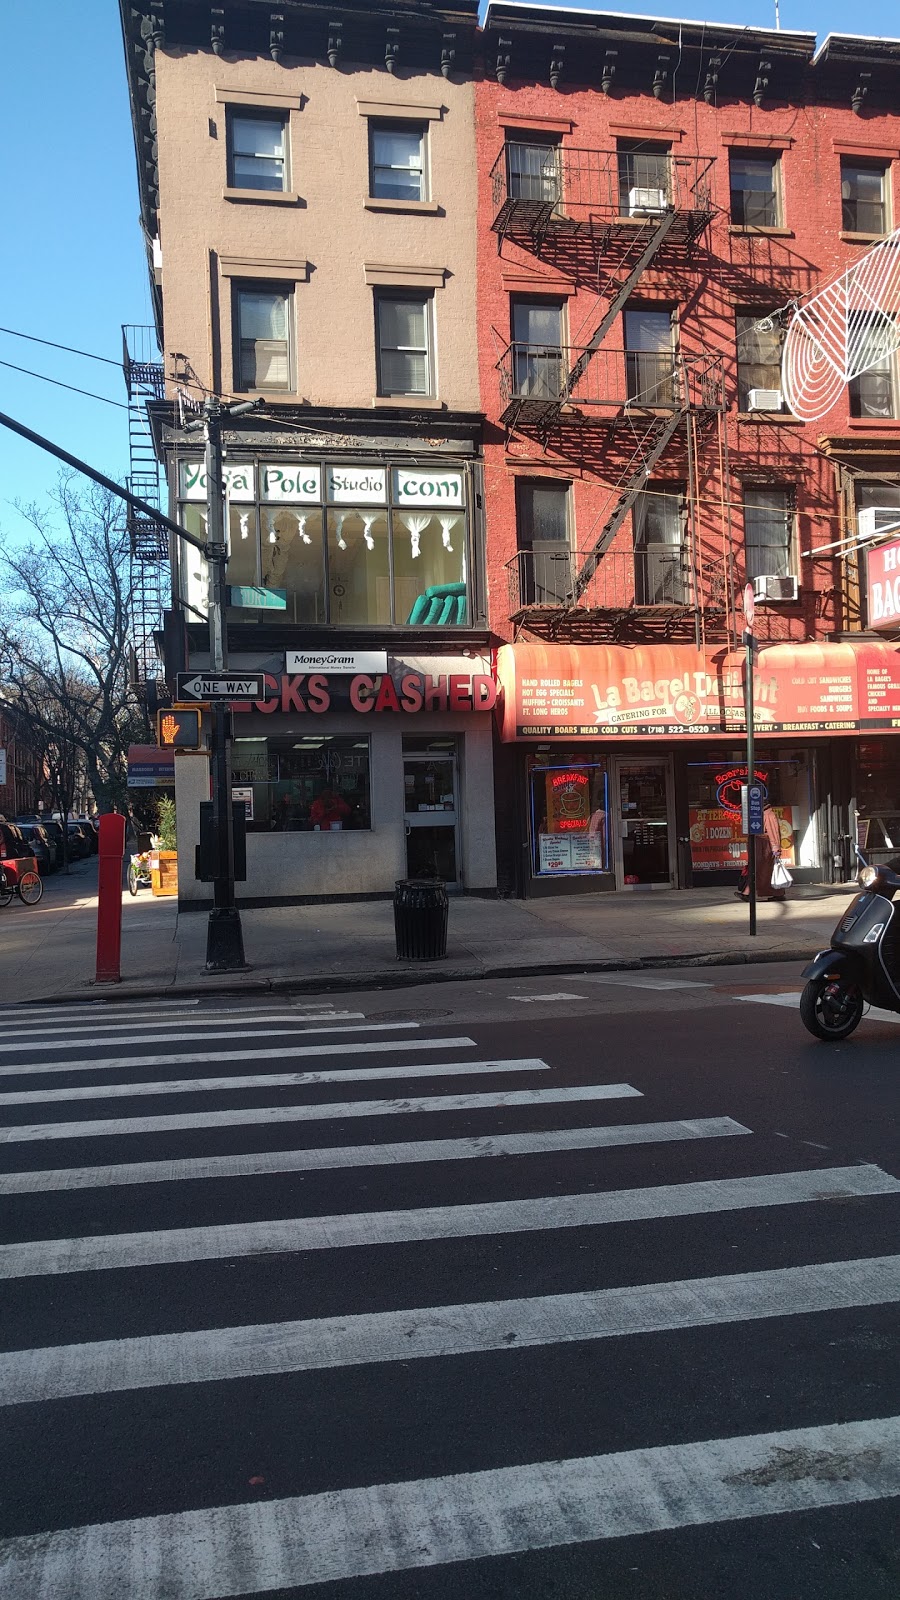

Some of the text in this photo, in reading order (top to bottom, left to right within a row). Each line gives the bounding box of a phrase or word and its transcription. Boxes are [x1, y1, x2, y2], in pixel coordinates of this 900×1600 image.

[264, 470, 317, 494] Pole
[329, 475, 383, 492] Studio
[397, 480, 459, 497] .com
[294, 655, 354, 665] MoneyGram
[194, 682, 252, 693] ONE WAY
[522, 679, 538, 687] HAND
[540, 679, 560, 687] ROLLED
[232, 674, 496, 713] CKS CASHED
[536, 689, 547, 697] EGG
[549, 689, 575, 697] SPECIALS
[591, 671, 778, 710] La Bagel Deliht
[522, 698, 585, 707] MUFFINS CROISSANTS
[836, 704, 853, 712] SOUPS
[522, 708, 568, 716] FT. LONG HEROS
[611, 708, 667, 722] CATERING FOR
[720, 709, 761, 720] OCCASNS
[522, 726, 552, 734] QUALITY
[554, 726, 578, 734] BOARS
[601, 726, 619, 734] COLD
[621, 726, 638, 734] CUTS
[647, 725, 665, 734] (718)
[782, 722, 820, 731] BREAKFAST
[824, 721, 856, 730] CATERING
[553, 773, 589, 787] BREAKFAST
[560, 819, 587, 829] SPECIALS
[710, 827, 731, 838] DOZEN
